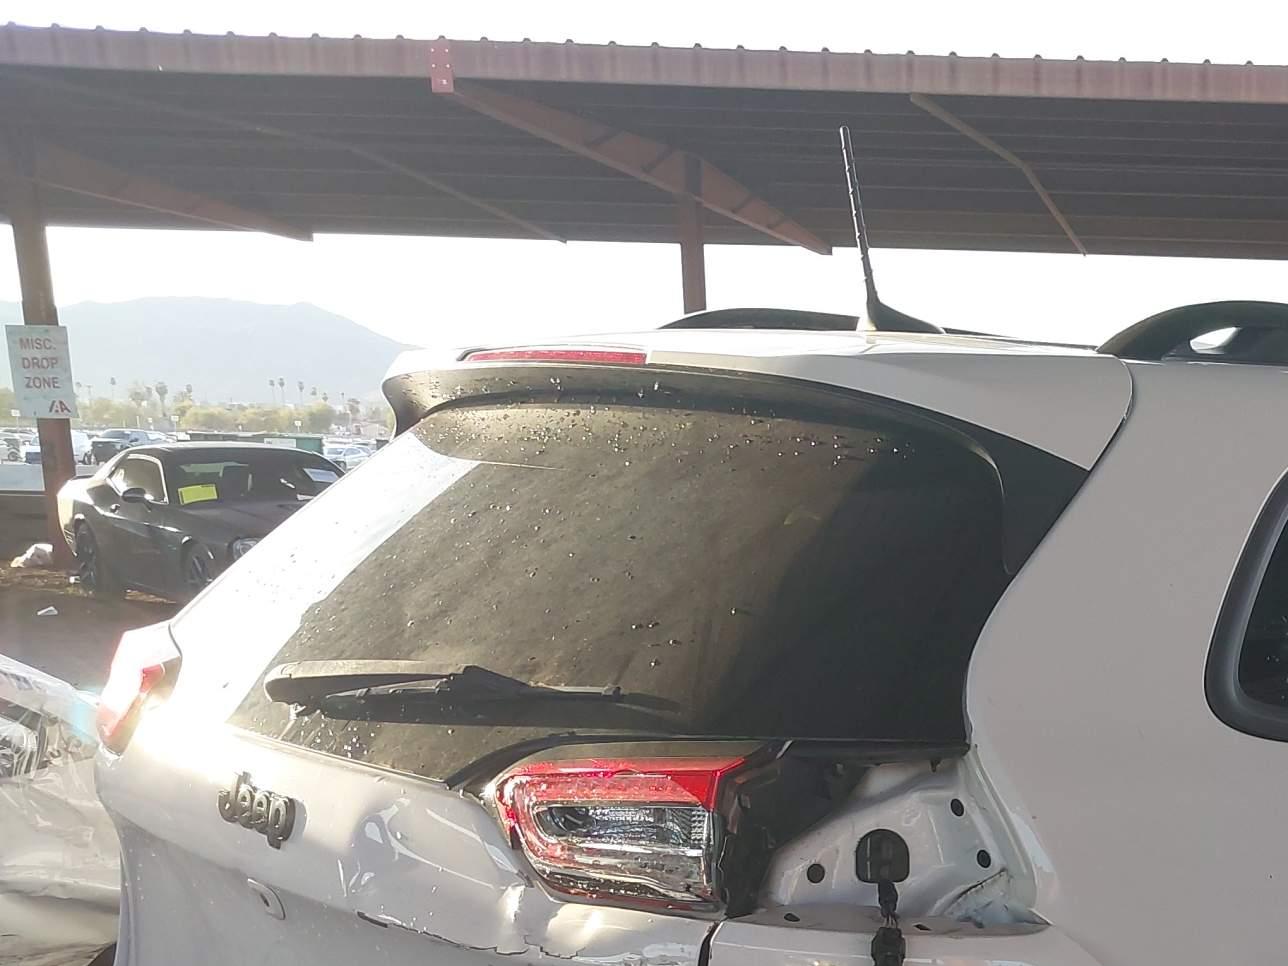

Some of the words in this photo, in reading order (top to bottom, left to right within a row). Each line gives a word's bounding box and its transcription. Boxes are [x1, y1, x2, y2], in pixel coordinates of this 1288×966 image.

[19, 338, 56, 350] MISC.
[22, 357, 58, 369] DROP
[24, 376, 61, 389] ZONE
[216, 770, 296, 850] Jeep
